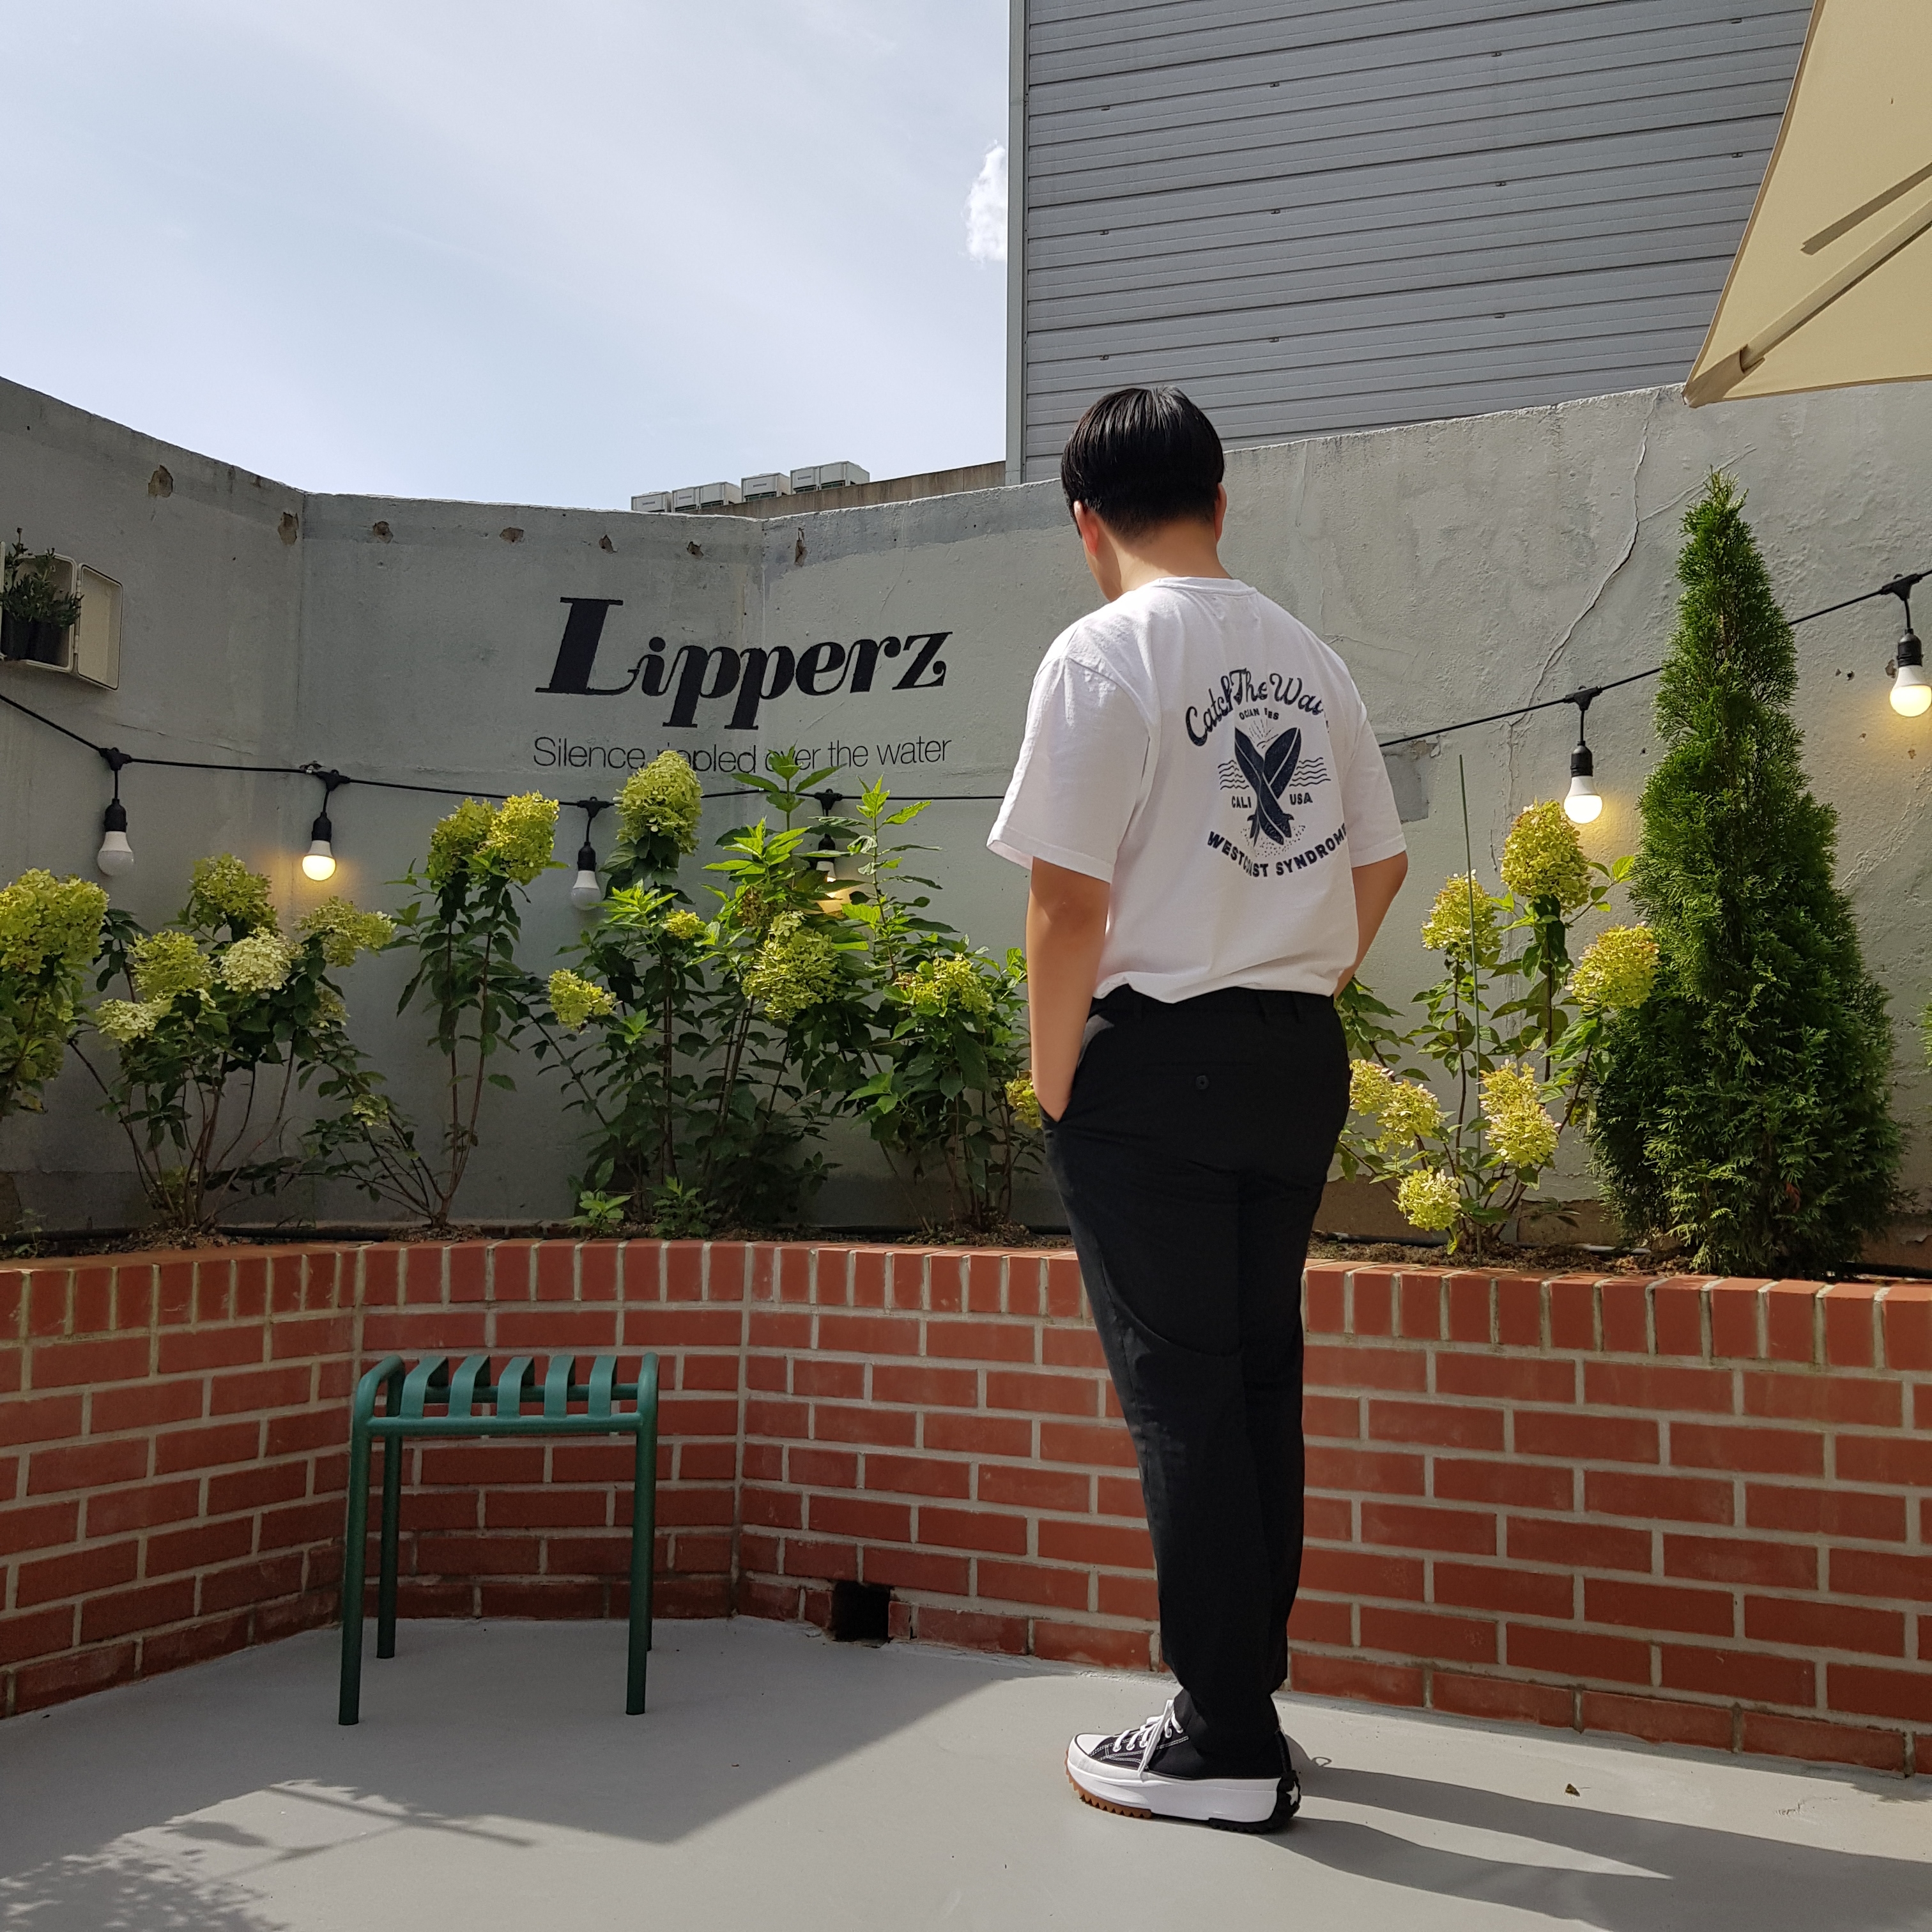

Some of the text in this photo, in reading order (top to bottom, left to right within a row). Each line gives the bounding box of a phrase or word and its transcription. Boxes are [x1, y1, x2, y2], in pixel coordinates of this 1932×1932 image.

[535, 597, 953, 730] Lipperz
[1229, 667, 1268, 705] The
[533, 735, 952, 774] Silence pled oer the water
[1231, 792, 1314, 808] CALI USA
